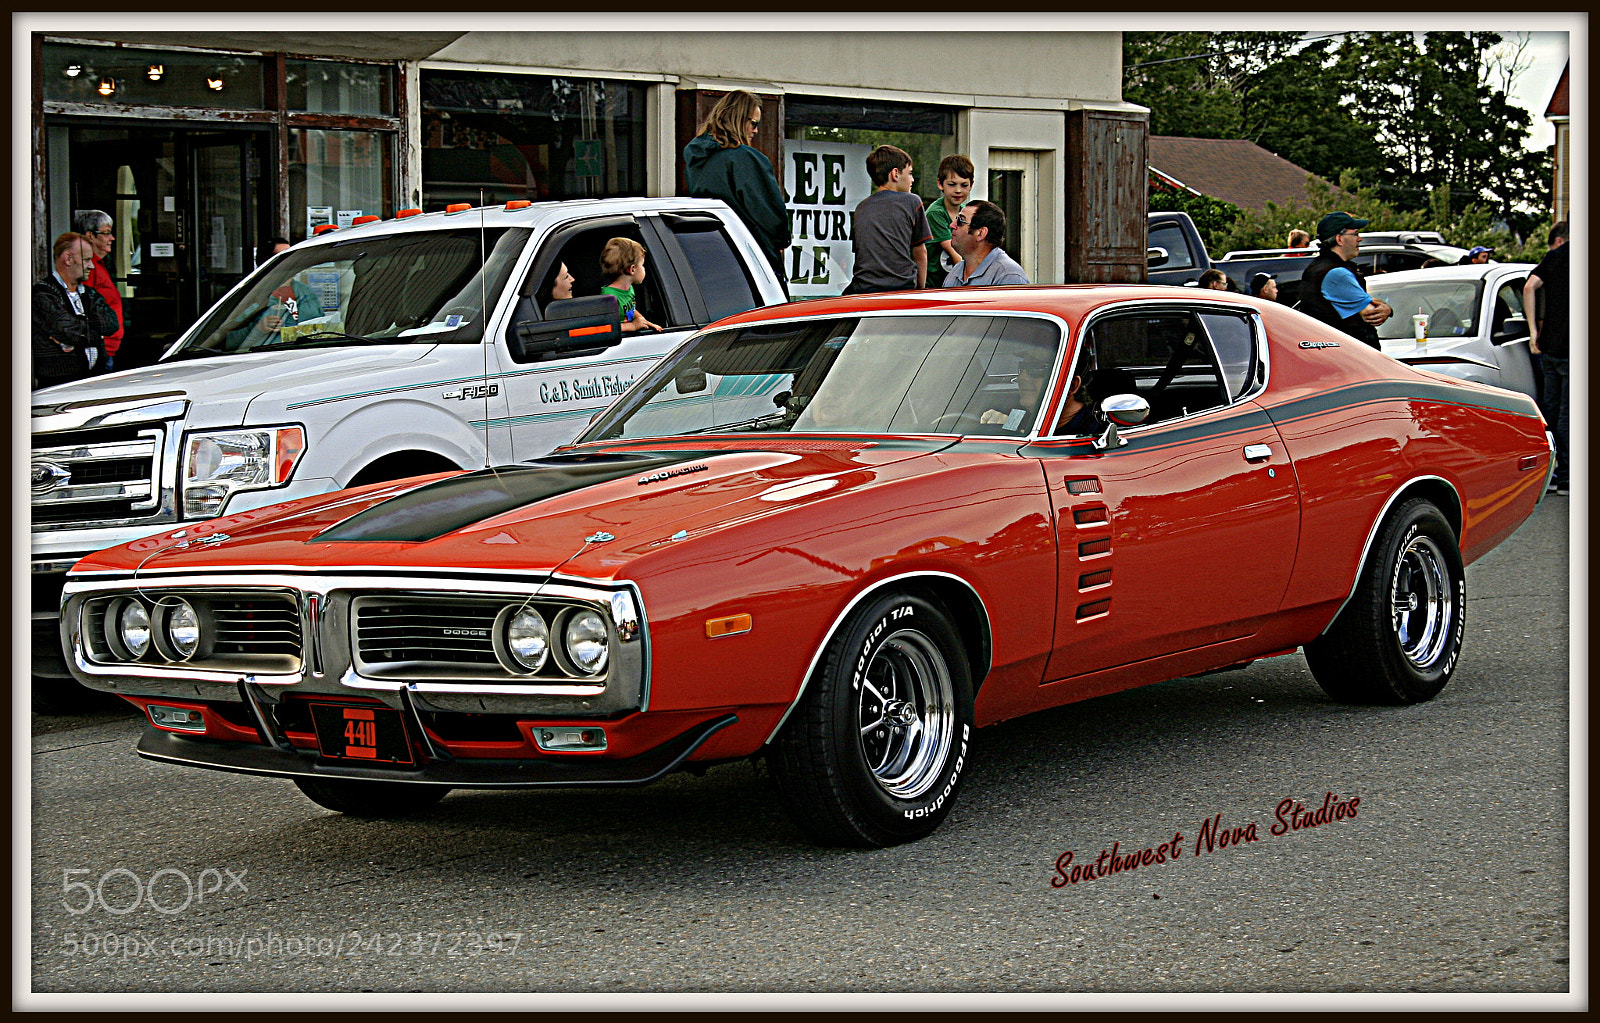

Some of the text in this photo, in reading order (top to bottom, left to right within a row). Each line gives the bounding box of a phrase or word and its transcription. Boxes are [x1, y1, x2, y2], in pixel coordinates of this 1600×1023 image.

[785, 152, 846, 205] EE
[790, 246, 830, 284] LE
[573, 376, 602, 400] Smith
[638, 471, 669, 486] 440
[1454, 579, 1465, 645] Radial
[853, 605, 914, 690] Radial T/A
[344, 720, 376, 747] 440
[904, 723, 970, 820] BFGoodrich
